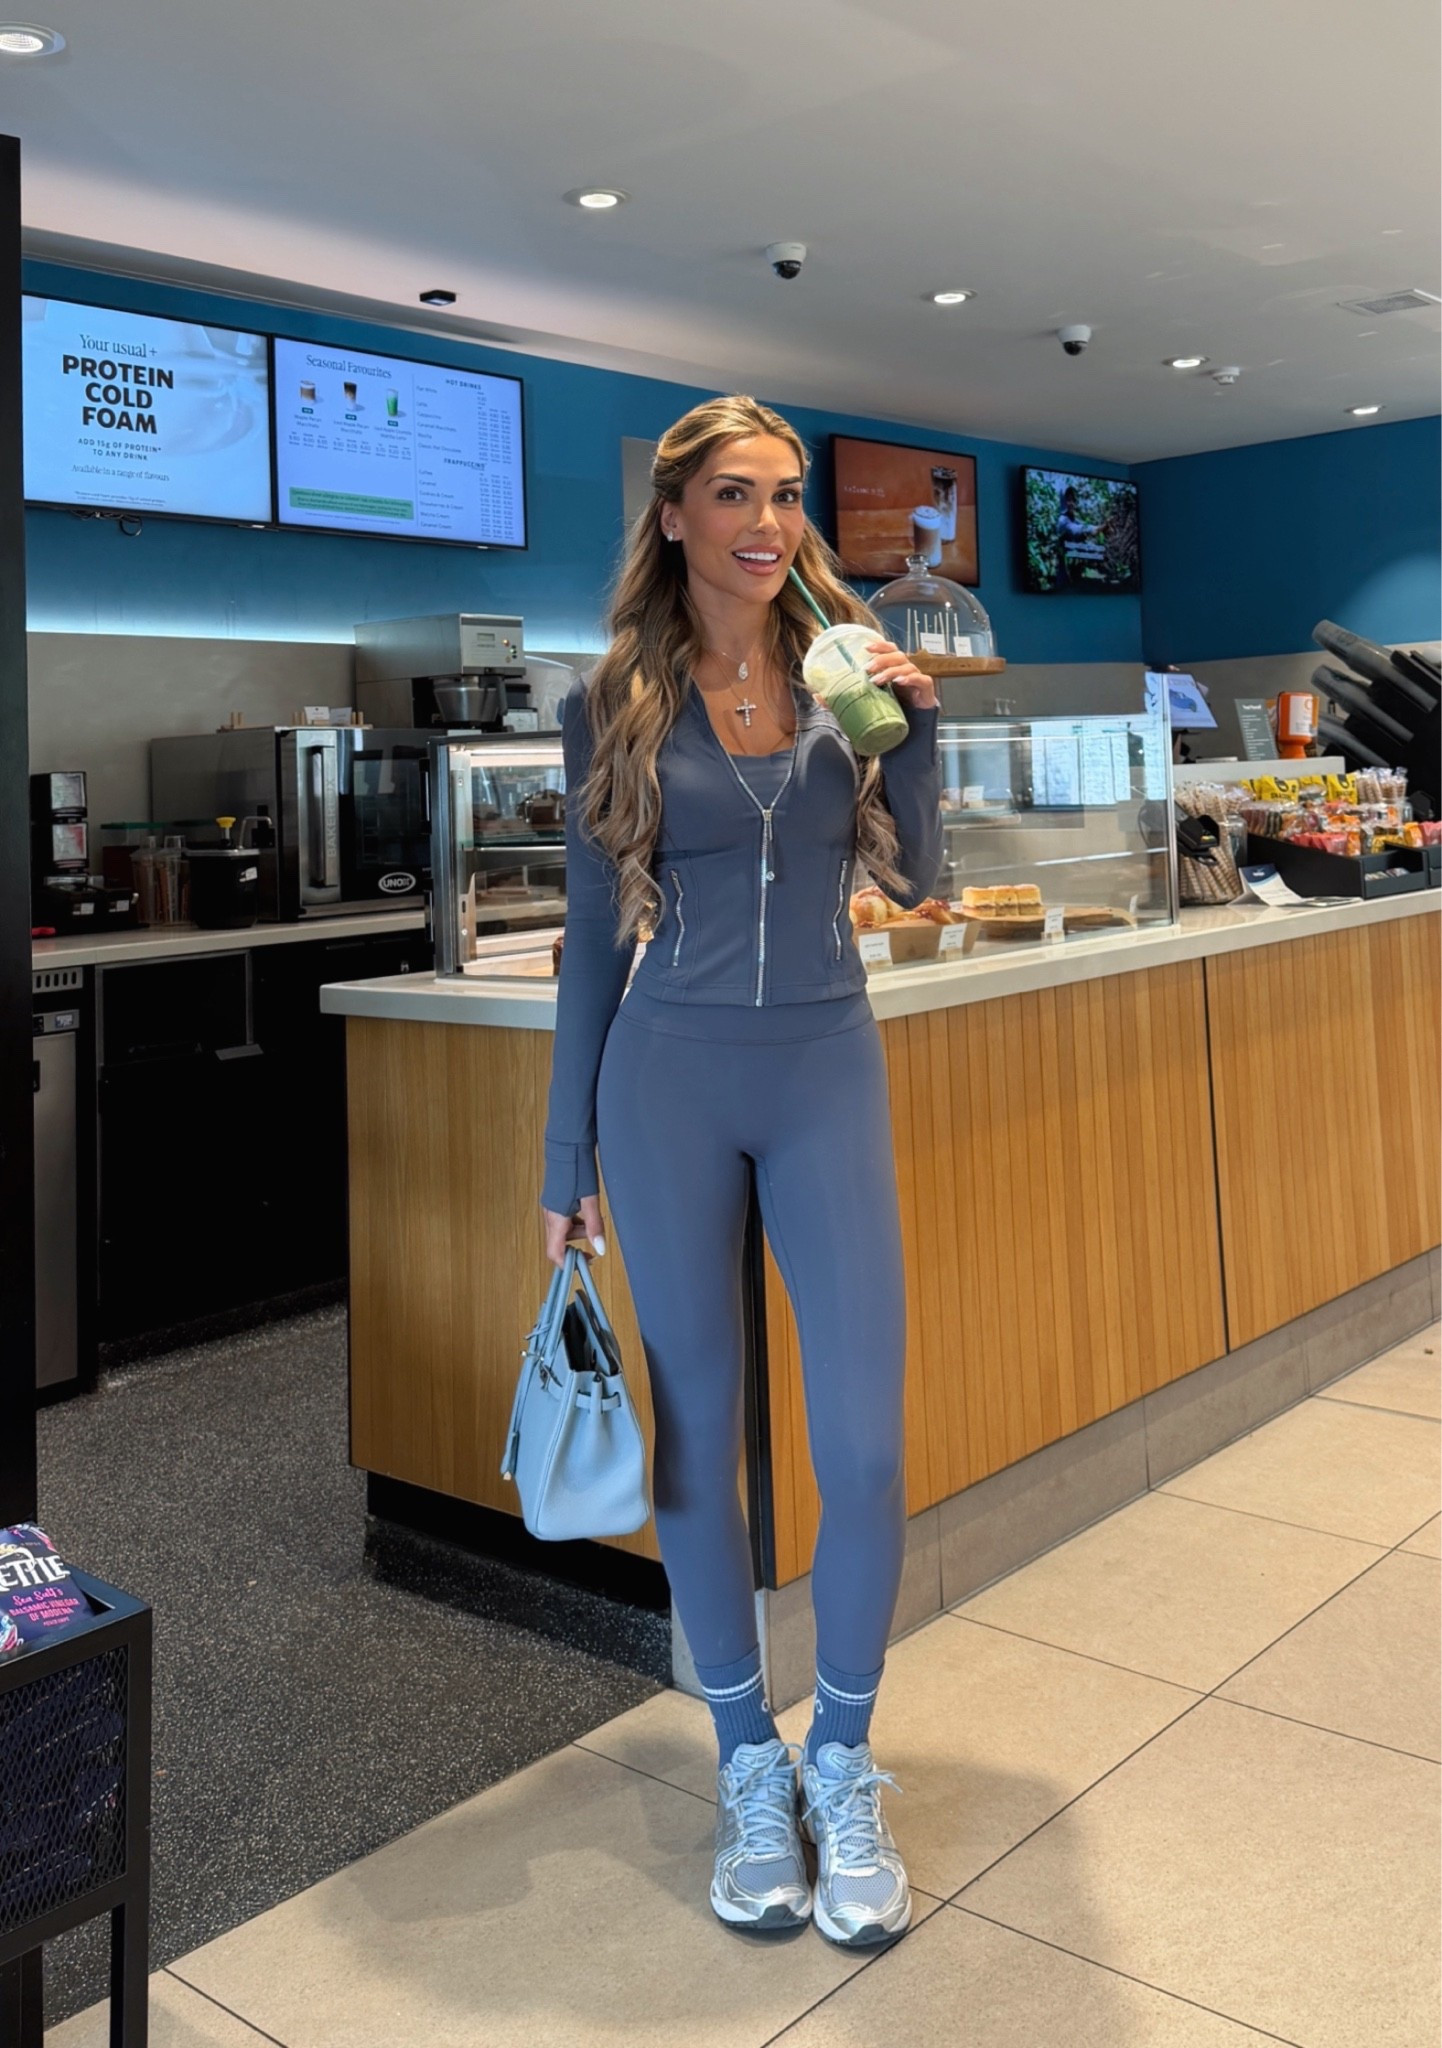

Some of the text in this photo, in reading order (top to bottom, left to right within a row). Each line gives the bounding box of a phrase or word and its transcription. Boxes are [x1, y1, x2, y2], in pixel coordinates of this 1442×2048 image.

[80, 334, 110, 352] Your
[112, 342, 147, 358] usual
[63, 354, 174, 390] PROTEIN
[306, 354, 392, 379] Seasonal Favourites
[459, 381, 482, 390] DRINKS
[85, 382, 153, 409] COLD
[82, 406, 157, 434] FOAM
[78, 438, 95, 446] ADD
[97, 440, 110, 449] 15g
[113, 441, 122, 449] OF
[123, 452, 148, 460] DRINK
[71, 464, 101, 474] Available
[103, 466, 110, 475] in
[117, 470, 135, 479] range
[136, 470, 143, 478] of
[144, 472, 170, 481] flavours
[383, 877, 410, 888] UNOX
[9, 1598, 80, 1616] BALSAMIC VINEGAR
[12, 1595, 33, 1606] Sea
[29, 1607, 74, 1621] OF MODENA
